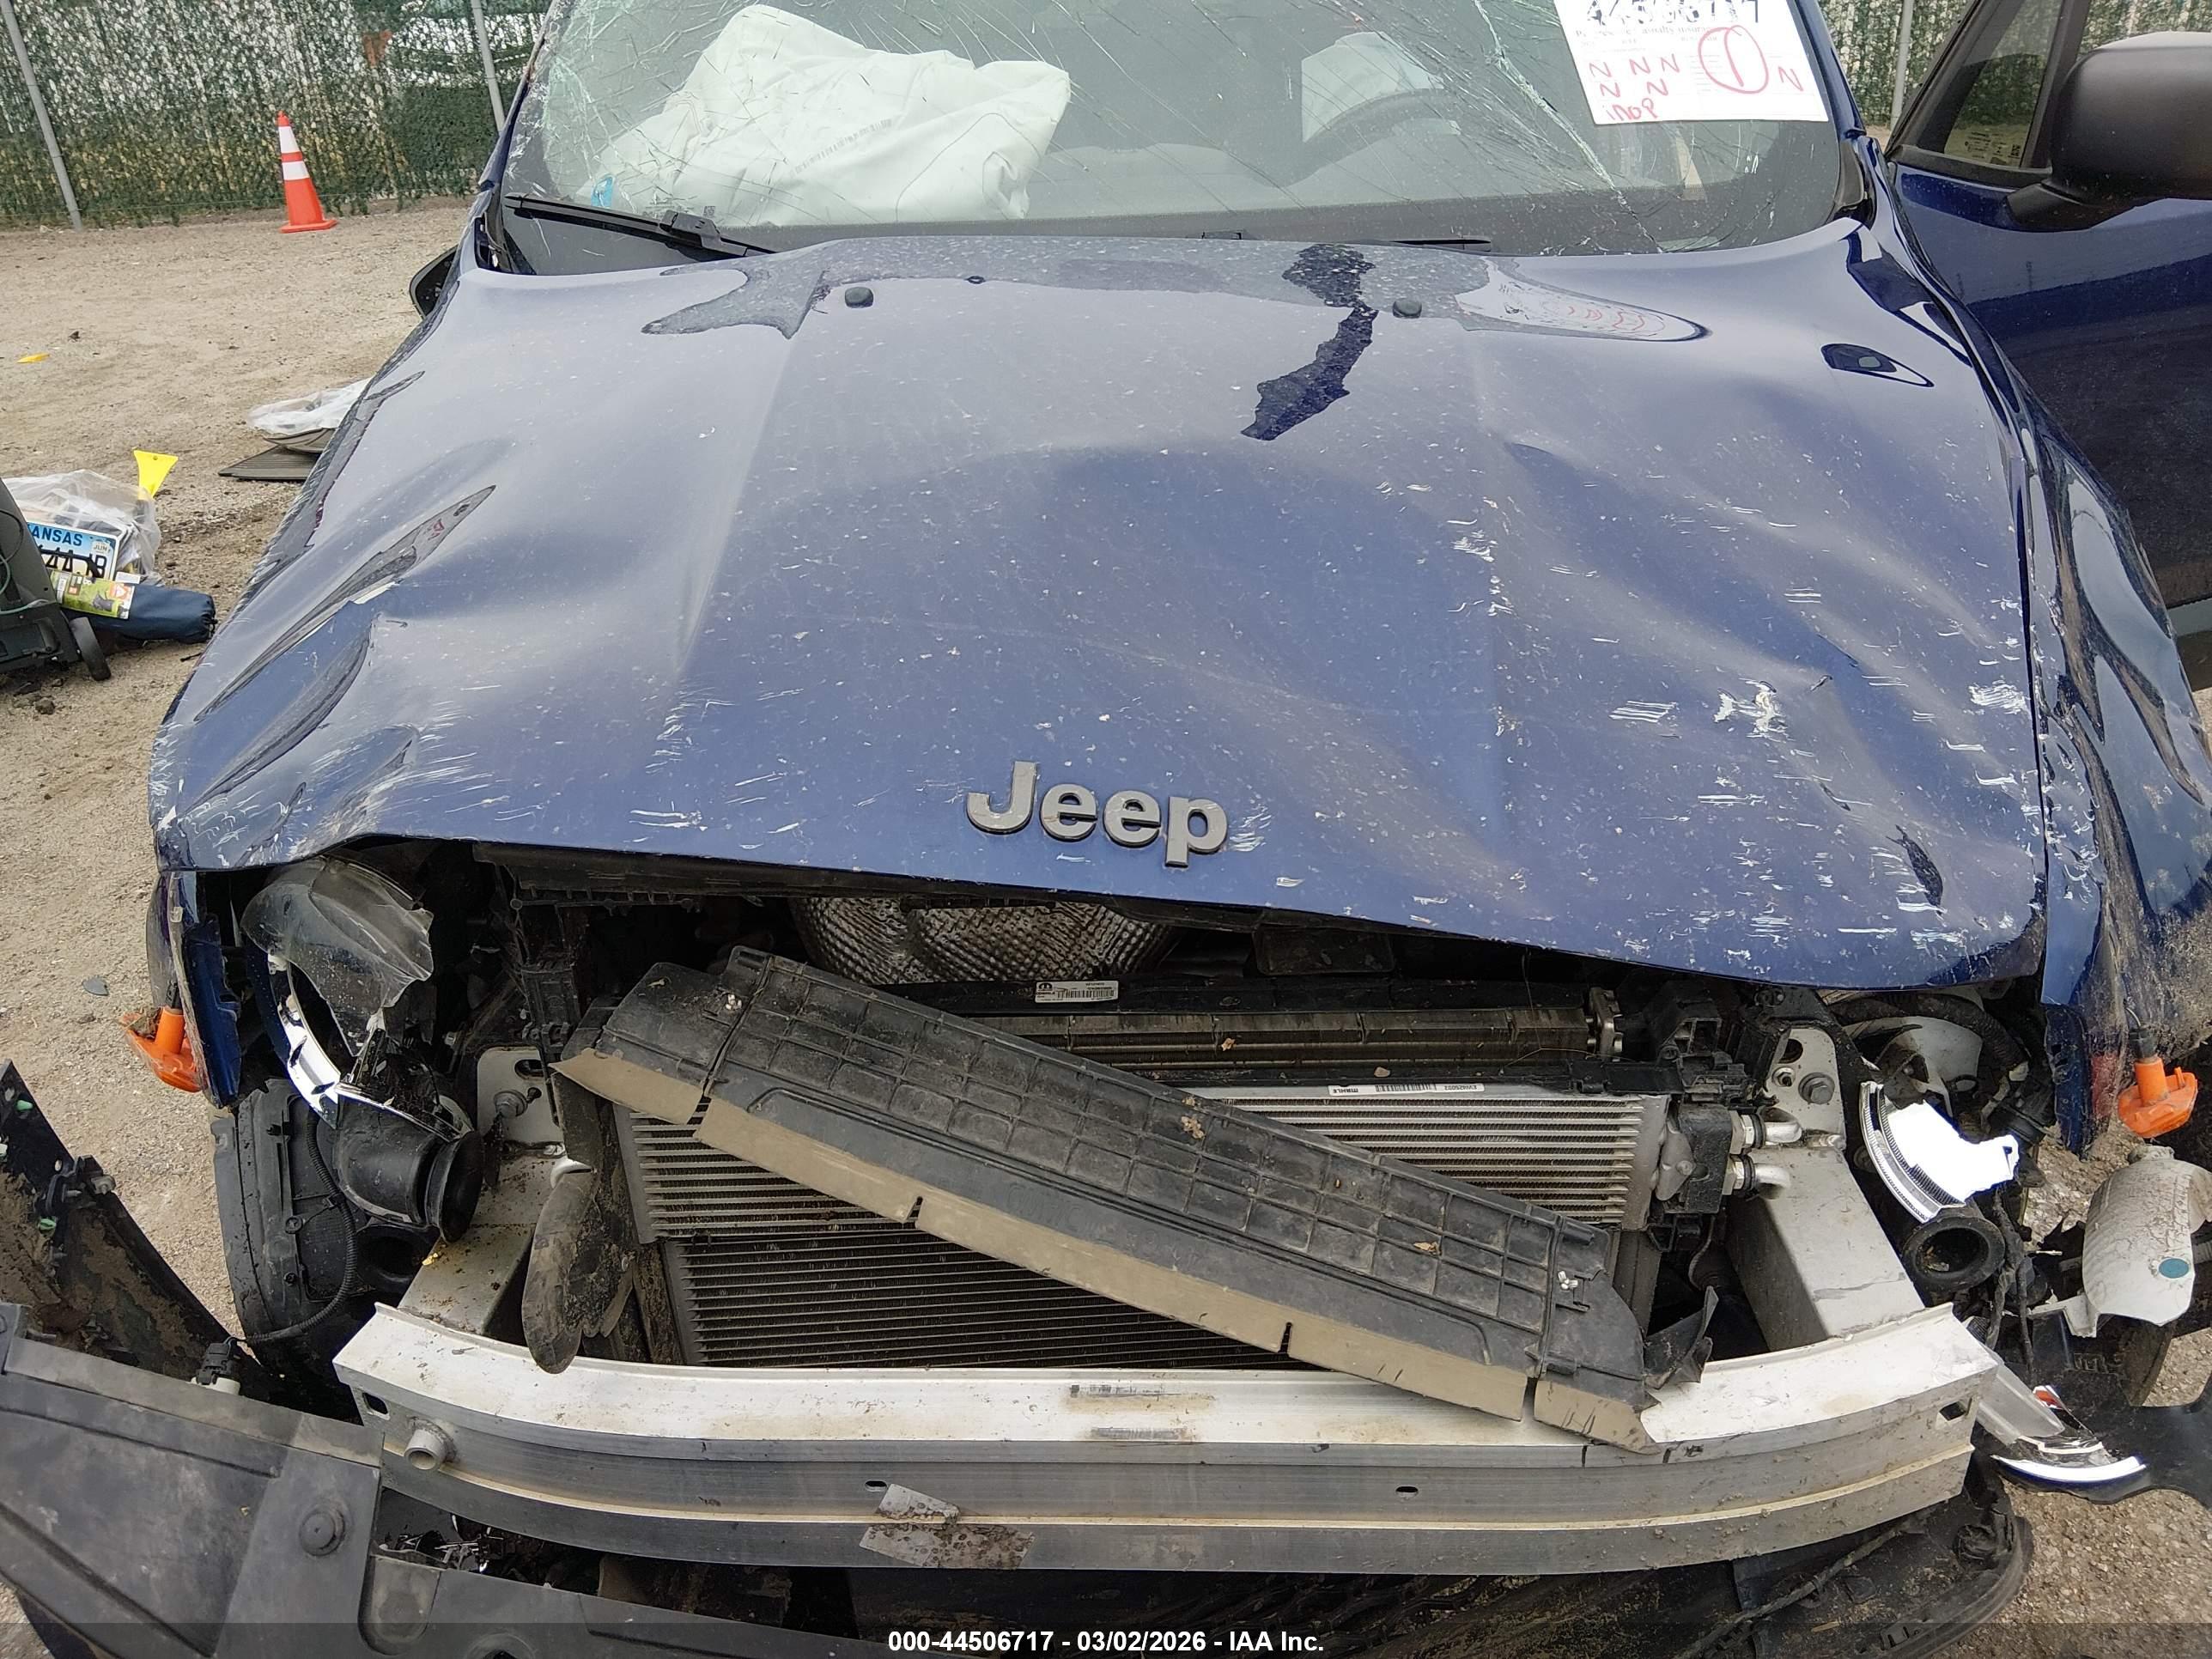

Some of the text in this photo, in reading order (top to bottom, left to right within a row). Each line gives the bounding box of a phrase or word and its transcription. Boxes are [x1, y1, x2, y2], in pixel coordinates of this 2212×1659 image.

[1630, 56, 1651, 75] N
[1661, 53, 1680, 74] N
[27, 524, 83, 546] ANSAS
[966, 760, 1229, 869] Jeep
